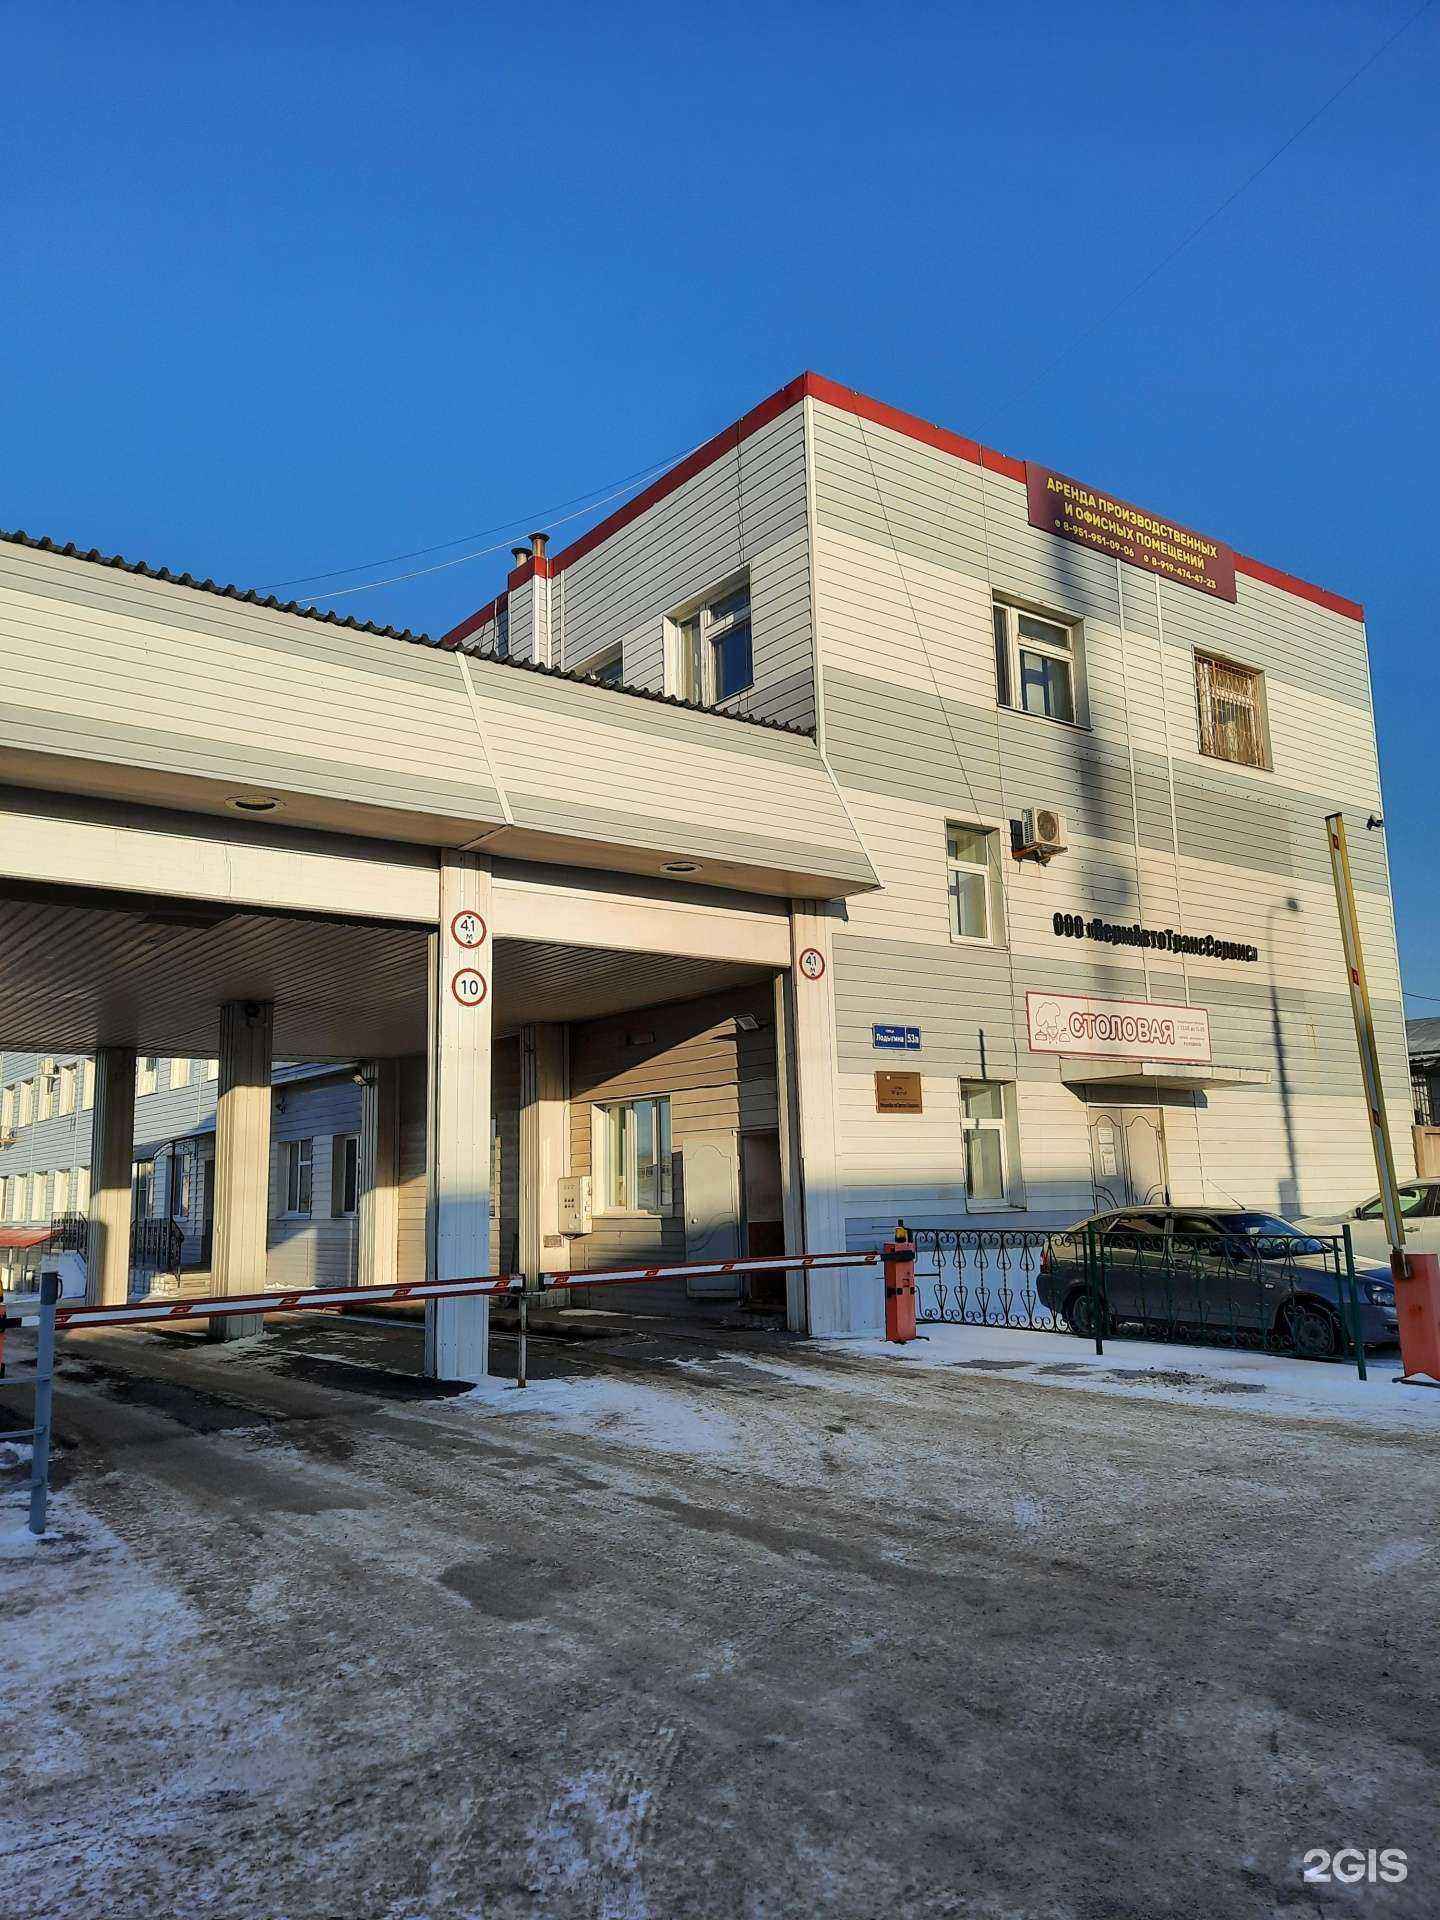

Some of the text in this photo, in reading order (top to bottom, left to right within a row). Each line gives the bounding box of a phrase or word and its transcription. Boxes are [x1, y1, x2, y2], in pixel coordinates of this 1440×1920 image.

[1047, 477, 1218, 559] АРЕНДА ПРОИЗВОДСТВЕННЫХ
[1064, 502, 1205, 570] И ОФИСНЫХ ПОМЕЩЕНИЙ
[1053, 912, 1084, 939] ООО
[461, 980, 479, 995] 10
[1069, 1011, 1176, 1045] СТОЛОВАЯ
